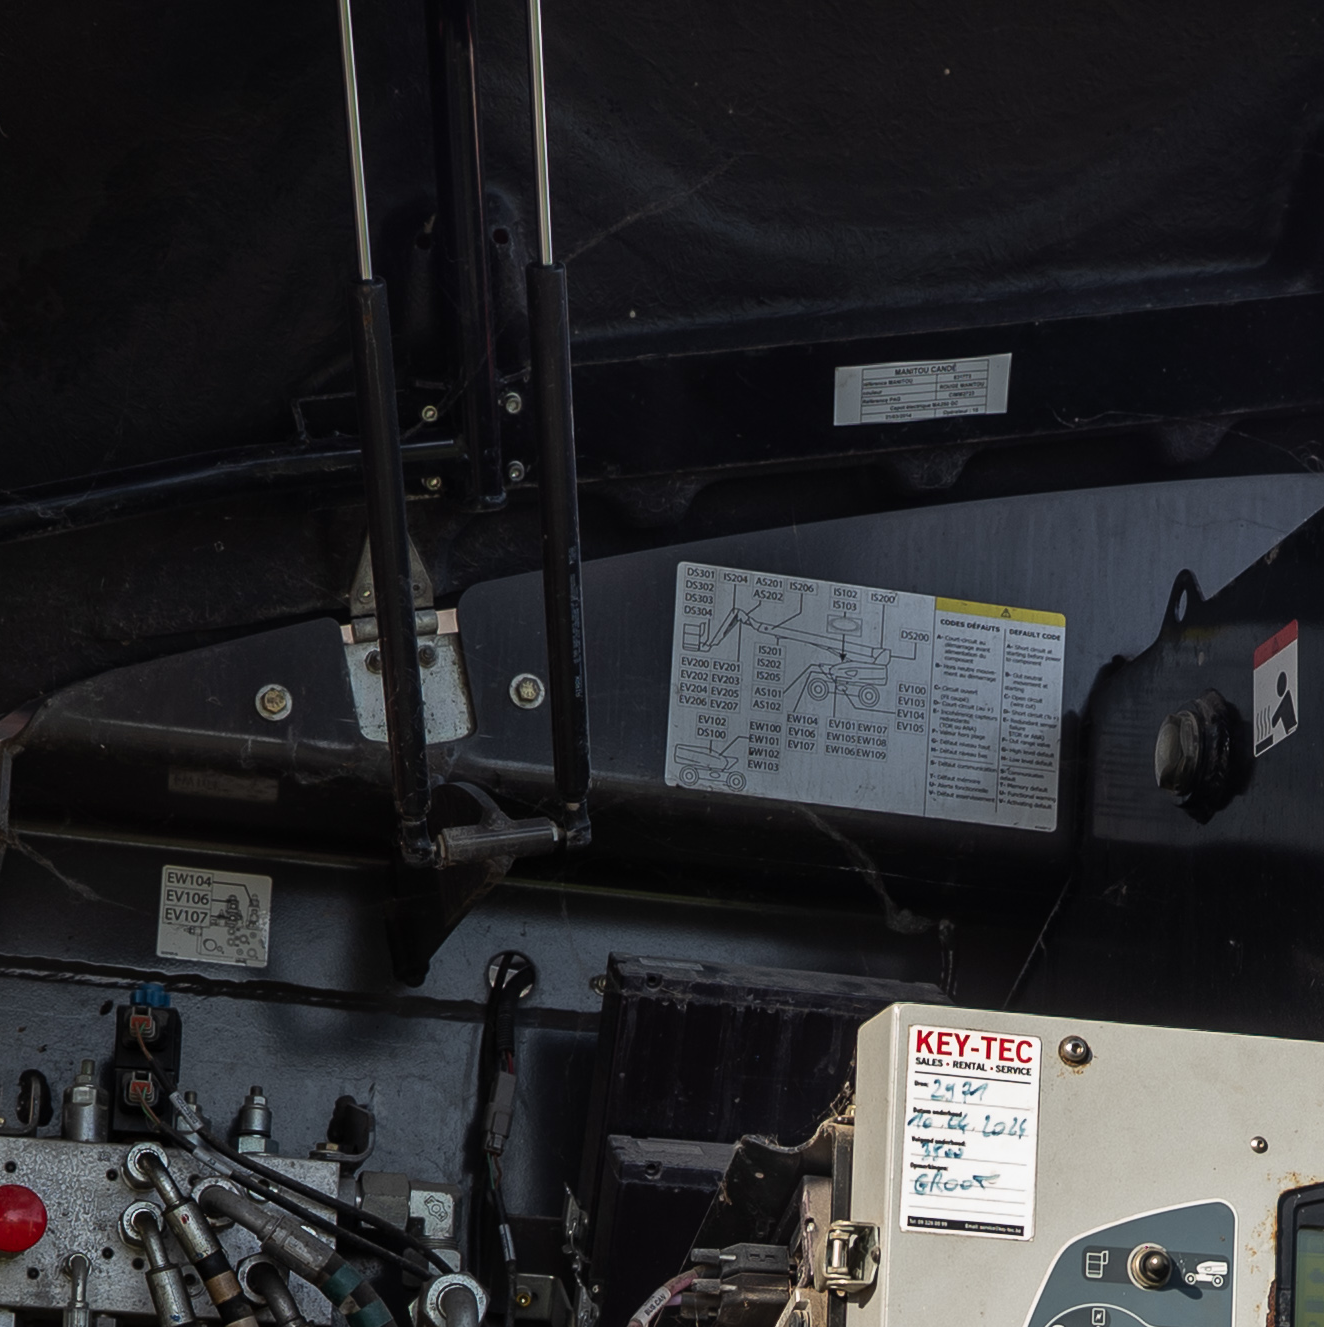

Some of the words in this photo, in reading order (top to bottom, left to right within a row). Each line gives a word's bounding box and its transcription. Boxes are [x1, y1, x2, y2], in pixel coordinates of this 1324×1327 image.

[895, 366, 929, 376] MANITOU
[931, 364, 956, 373] CANDÉ
[687, 568, 714, 578] DS301
[724, 573, 748, 583] IS204
[686, 580, 714, 592] DS302
[756, 577, 782, 588] AS201
[790, 582, 814, 592] IS206
[685, 593, 713, 604] DS303
[753, 590, 783, 600] AS202
[834, 588, 857, 598] IS102
[871, 593, 895, 603] IS200
[684, 605, 712, 616] DS304
[833, 601, 857, 611] IS103
[940, 619, 965, 628] CODES
[901, 631, 929, 642] DS200
[1009, 629, 1040, 638] DEFAULT
[759, 646, 781, 656] IS201
[681, 657, 709, 668] EV200
[713, 661, 740, 672] EV201
[757, 658, 781, 669] IS202
[681, 670, 708, 680] EV202
[712, 674, 739, 685] EV203
[757, 671, 781, 681] IS205
[680, 682, 707, 693] EV204
[711, 686, 739, 698] EV205
[755, 687, 781, 698] AS101
[899, 684, 926, 695] EV100
[679, 695, 707, 706] EV206
[710, 700, 738, 710] EV207
[753, 700, 781, 710] AS102
[898, 696, 925, 707] EV103
[787, 714, 818, 725] EW104
[897, 709, 924, 720] EV104
[698, 715, 726, 726] EV102
[829, 719, 855, 730] EV101
[750, 721, 781, 732] EW100
[858, 723, 887, 734] EW107
[896, 722, 923, 732] EV105
[697, 728, 726, 739] DS100
[788, 727, 815, 738] EV106
[827, 732, 856, 743] EW105
[749, 734, 779, 746] EW101
[788, 740, 815, 751] EV107
[857, 736, 886, 747] EW108
[749, 747, 779, 758] EW102
[826, 745, 856, 756] EW106
[856, 749, 886, 760] EW109
[748, 760, 779, 771] EW103
[167, 872, 212, 888] EW104
[166, 890, 210, 905] EV106
[165, 908, 208, 923] EV107
[916, 1030, 1033, 1063] KEY-TEC
[916, 1057, 943, 1067] SALES
[953, 1060, 987, 1071] RENTAL
[996, 1065, 1031, 1076] SERVICE
